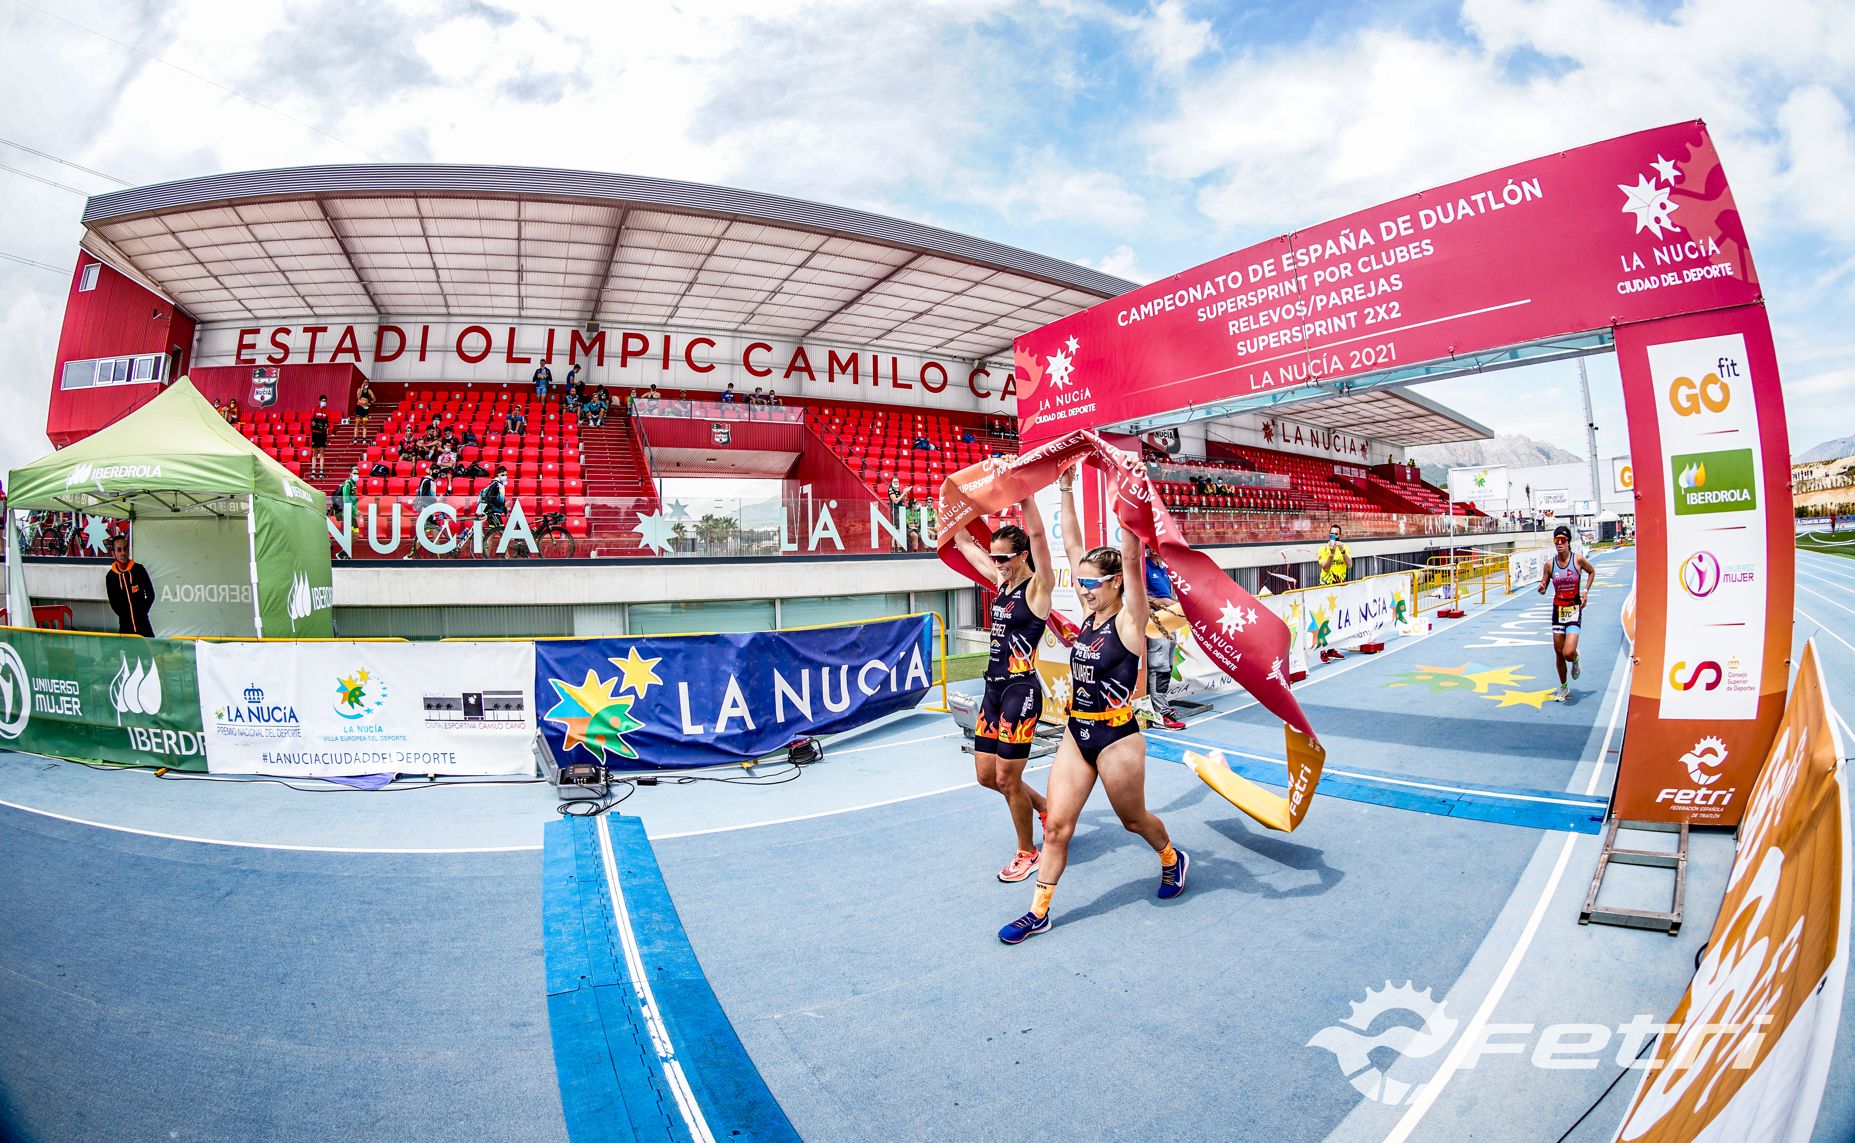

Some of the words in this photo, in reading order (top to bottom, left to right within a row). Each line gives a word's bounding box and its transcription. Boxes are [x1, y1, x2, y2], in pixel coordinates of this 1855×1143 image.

[1117, 271, 1243, 327] CAMPEONATO
[1248, 259, 1277, 282] DE
[1281, 228, 1375, 272] ESPAÑA
[1379, 215, 1414, 242] DE
[1418, 177, 1543, 230] DUATLÓN
[1621, 251, 1644, 272] LA
[1197, 275, 1308, 322] SUPERSPRINT
[1314, 262, 1353, 286] POR
[1357, 239, 1434, 274] CLUBES
[1617, 274, 1659, 294] CIUDAD
[1662, 271, 1682, 286] DEL
[1684, 262, 1733, 283] DEPORTE
[1228, 274, 1402, 335] RELEVOS/PAREJAS
[1237, 311, 1358, 356] SUPERSPRINT
[1365, 301, 1401, 325] 2X2
[235, 325, 429, 365] ESTADI
[456, 325, 717, 376] OLIMPIC
[742, 342, 948, 394] CAMILO
[1250, 370, 1276, 389] LA
[1280, 354, 1344, 384] NUCÍA
[1350, 342, 1397, 369] 2021
[1670, 373, 1730, 417] GO
[1718, 357, 1740, 378] fit
[1035, 412, 1056, 424] CIUDAD
[1057, 410, 1067, 420] DEL
[1068, 403, 1096, 417] DEPORTE
[1039, 399, 1050, 410] LA
[1281, 422, 1304, 445] LA
[91, 465, 162, 480] IBERDROLA
[1686, 489, 1750, 505] IBERDROLA
[780, 502, 845, 551] LA
[1168, 571, 1191, 595] 2X2
[1723, 573, 1754, 583] MUJER
[1194, 620, 1207, 633] LA
[1338, 609, 1351, 629] LA
[1213, 648, 1238, 672] DEPORTE
[1728, 671, 1747, 679] Consejo
[32, 678, 79, 695] UNIVERSO
[35, 694, 82, 716] MUJER
[227, 706, 245, 722] LA
[678, 673, 756, 735] LA
[217, 726, 237, 736] PREMIO
[238, 727, 264, 737] NACIONAL
[265, 728, 276, 737] DEL
[277, 728, 301, 738] DEPORTE
[1655, 787, 1735, 805] Fetri
